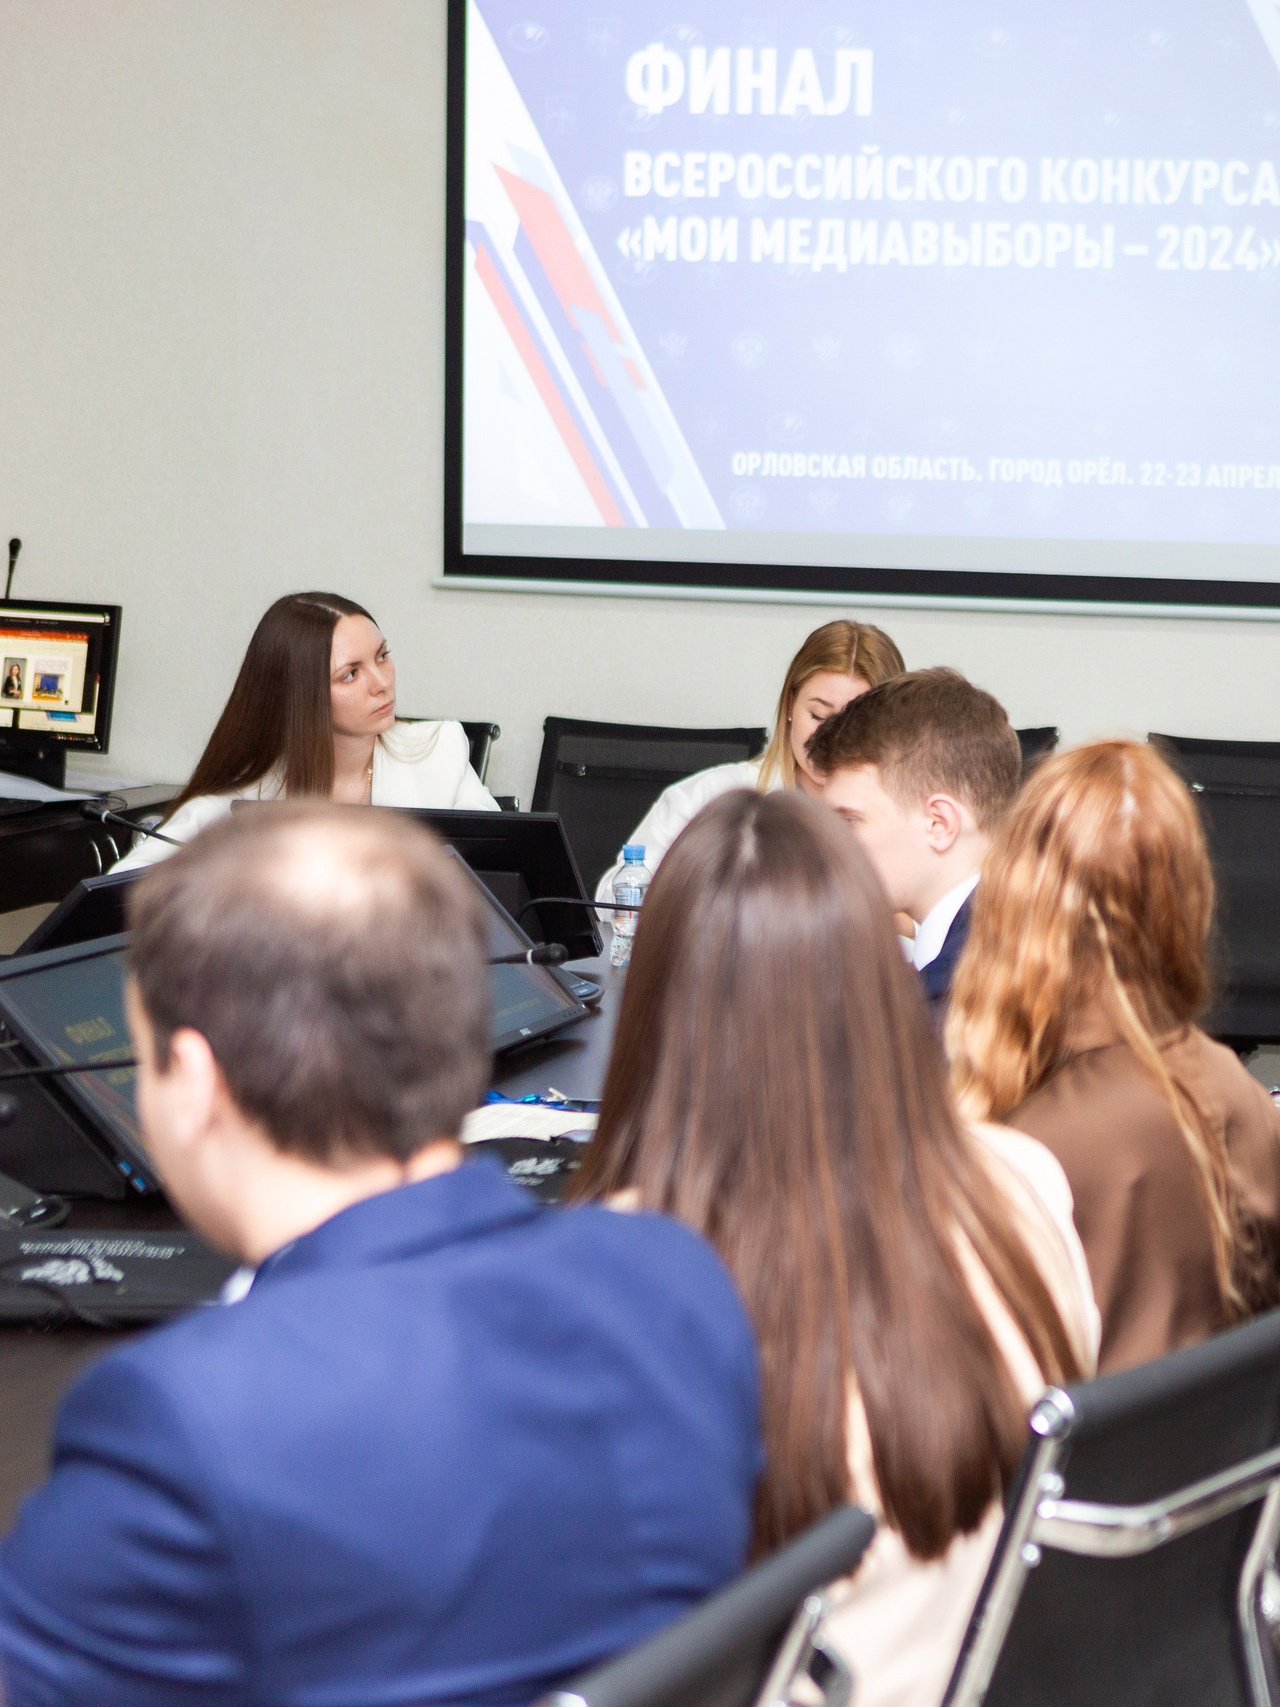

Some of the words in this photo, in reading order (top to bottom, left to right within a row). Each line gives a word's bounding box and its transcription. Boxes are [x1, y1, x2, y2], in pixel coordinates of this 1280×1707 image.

[626, 42, 873, 116] ФИНАЛ
[624, 144, 1028, 203] ВСЕРОССИЙСКОГО
[616, 214, 738, 263] «МОИ
[751, 216, 1114, 273] МЕДИАВЫБОРЫ
[732, 452, 866, 479] ОРЛОВСКАЯ
[989, 458, 1063, 487] ГОРОД
[1140, 462, 1201, 486] 22-23
